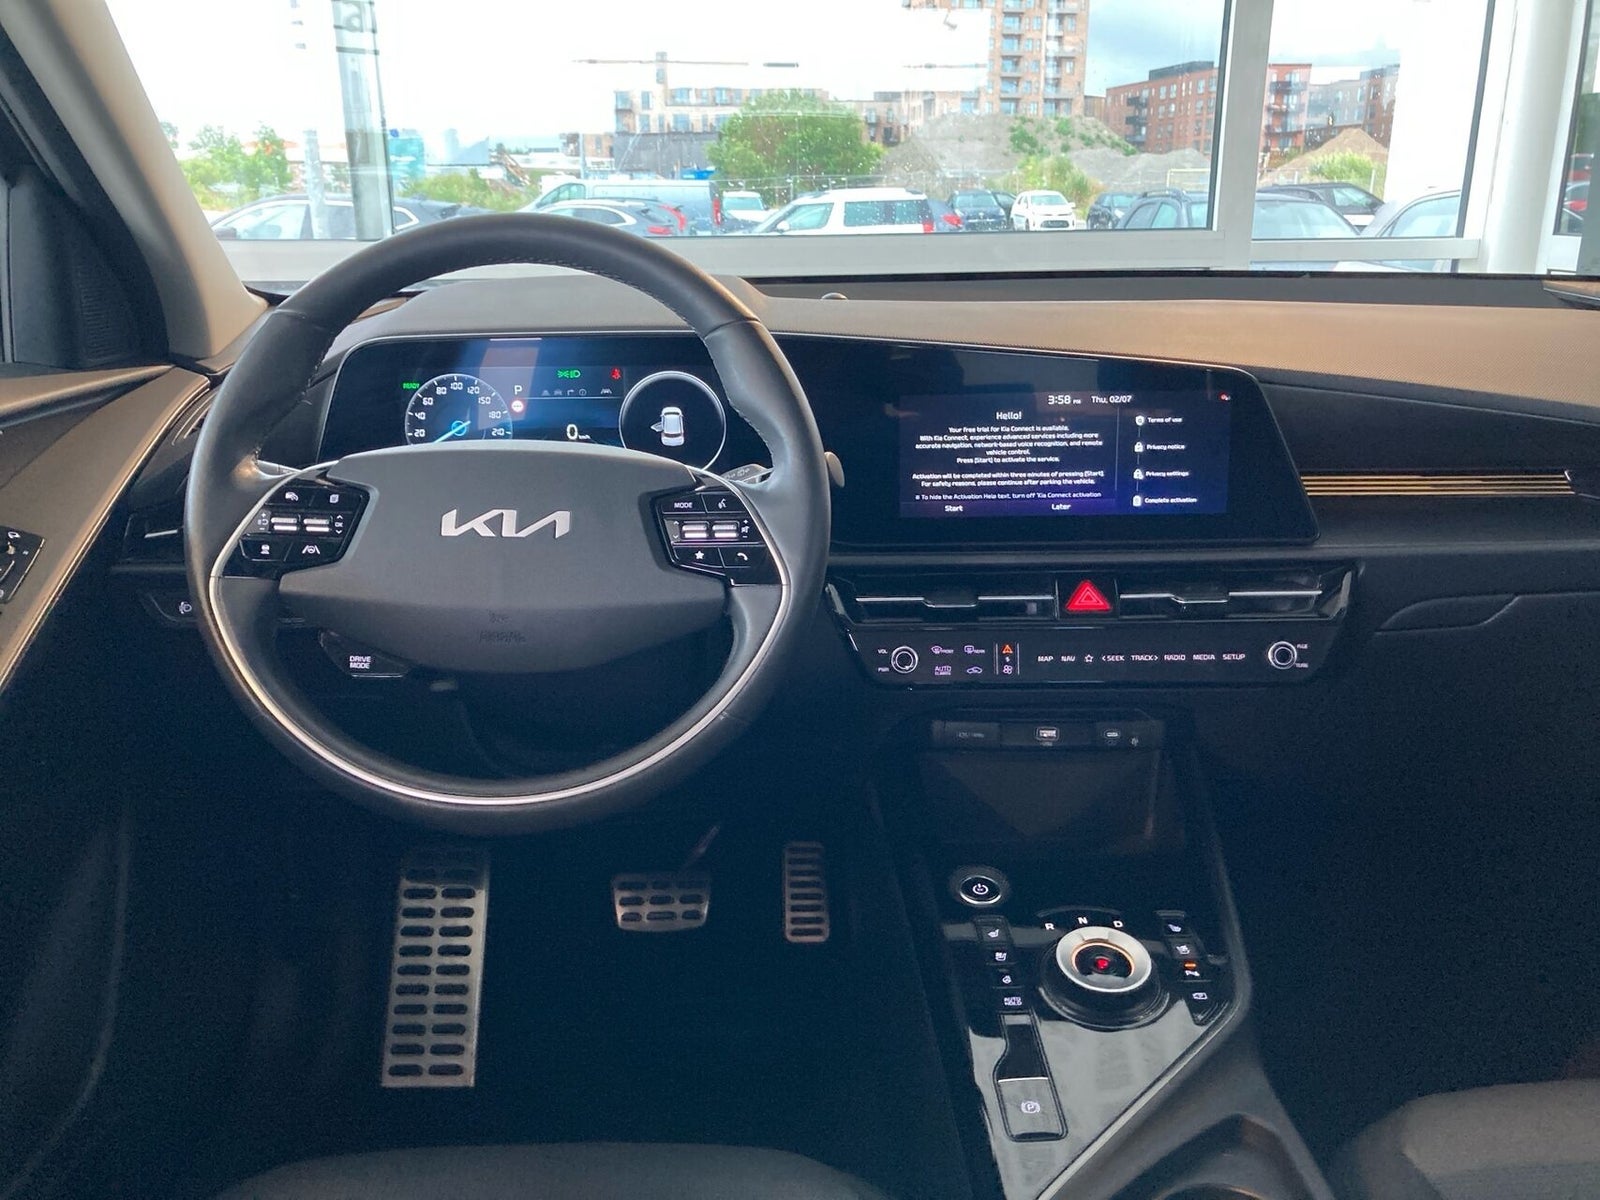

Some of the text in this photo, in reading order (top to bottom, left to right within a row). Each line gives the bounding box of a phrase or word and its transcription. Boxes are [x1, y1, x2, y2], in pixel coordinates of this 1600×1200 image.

[436, 386, 447, 395] 80
[450, 382, 464, 390] 100
[467, 386, 480, 394] 120
[514, 384, 523, 396] P
[422, 398, 434, 406] 60
[1048, 394, 1071, 404] 3:58
[1091, 395, 1132, 404] Thu, 02/07
[414, 412, 426, 420] 40
[488, 411, 502, 419] 180
[996, 411, 1022, 420] Hello!
[414, 429, 426, 438] 20
[492, 428, 505, 436] 210
[566, 424, 578, 440] 0
[441, 508, 571, 538] KIA
[1078, 916, 1088, 925] N
[1113, 920, 1124, 928] D
[1044, 922, 1055, 931] R
